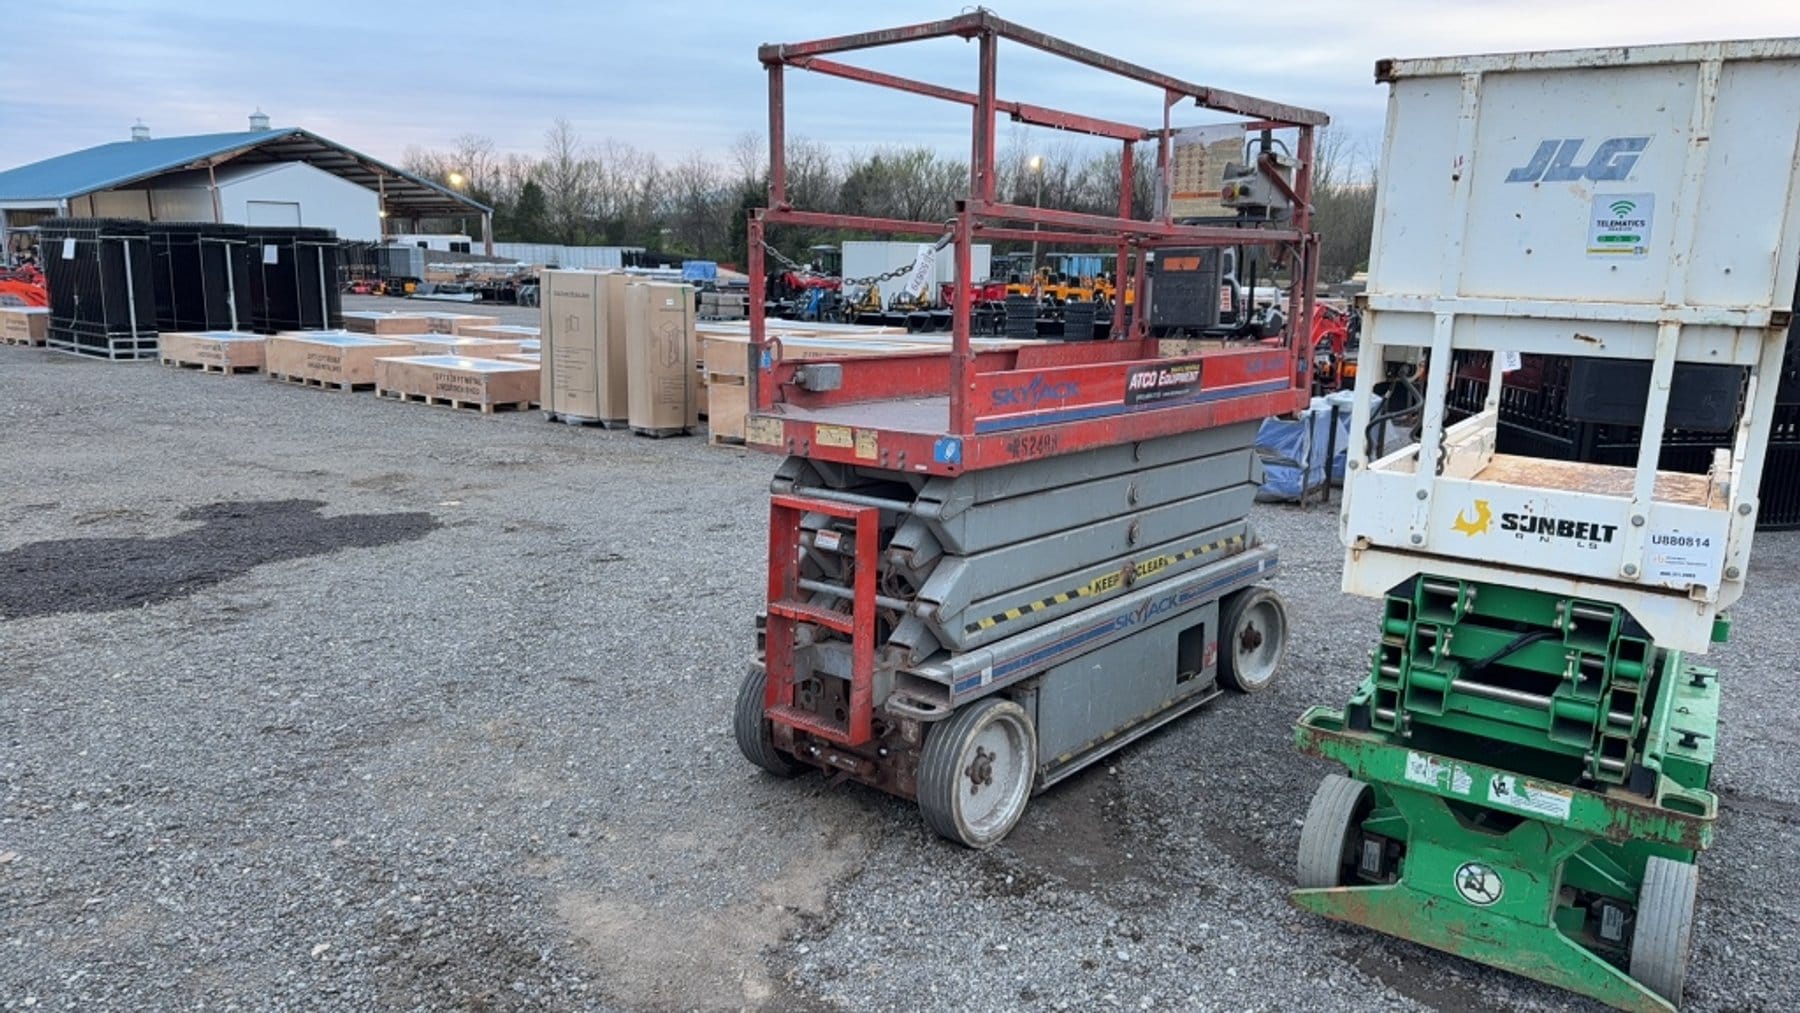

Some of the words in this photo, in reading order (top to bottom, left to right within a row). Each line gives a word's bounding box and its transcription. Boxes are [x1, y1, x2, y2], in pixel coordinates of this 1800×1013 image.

[1504, 137, 1651, 183] JLG
[1597, 219, 1646, 228] TELEMATICS
[991, 373, 1080, 410] SKYJACK
[1128, 370, 1158, 391] ATCO
[1501, 512, 1618, 543] SUNBELT
[1652, 535, 1710, 548] U880814
[1094, 573, 1120, 593] KEEP
[1136, 557, 1166, 577] CLEAR
[1114, 592, 1179, 631] SKYJACK
